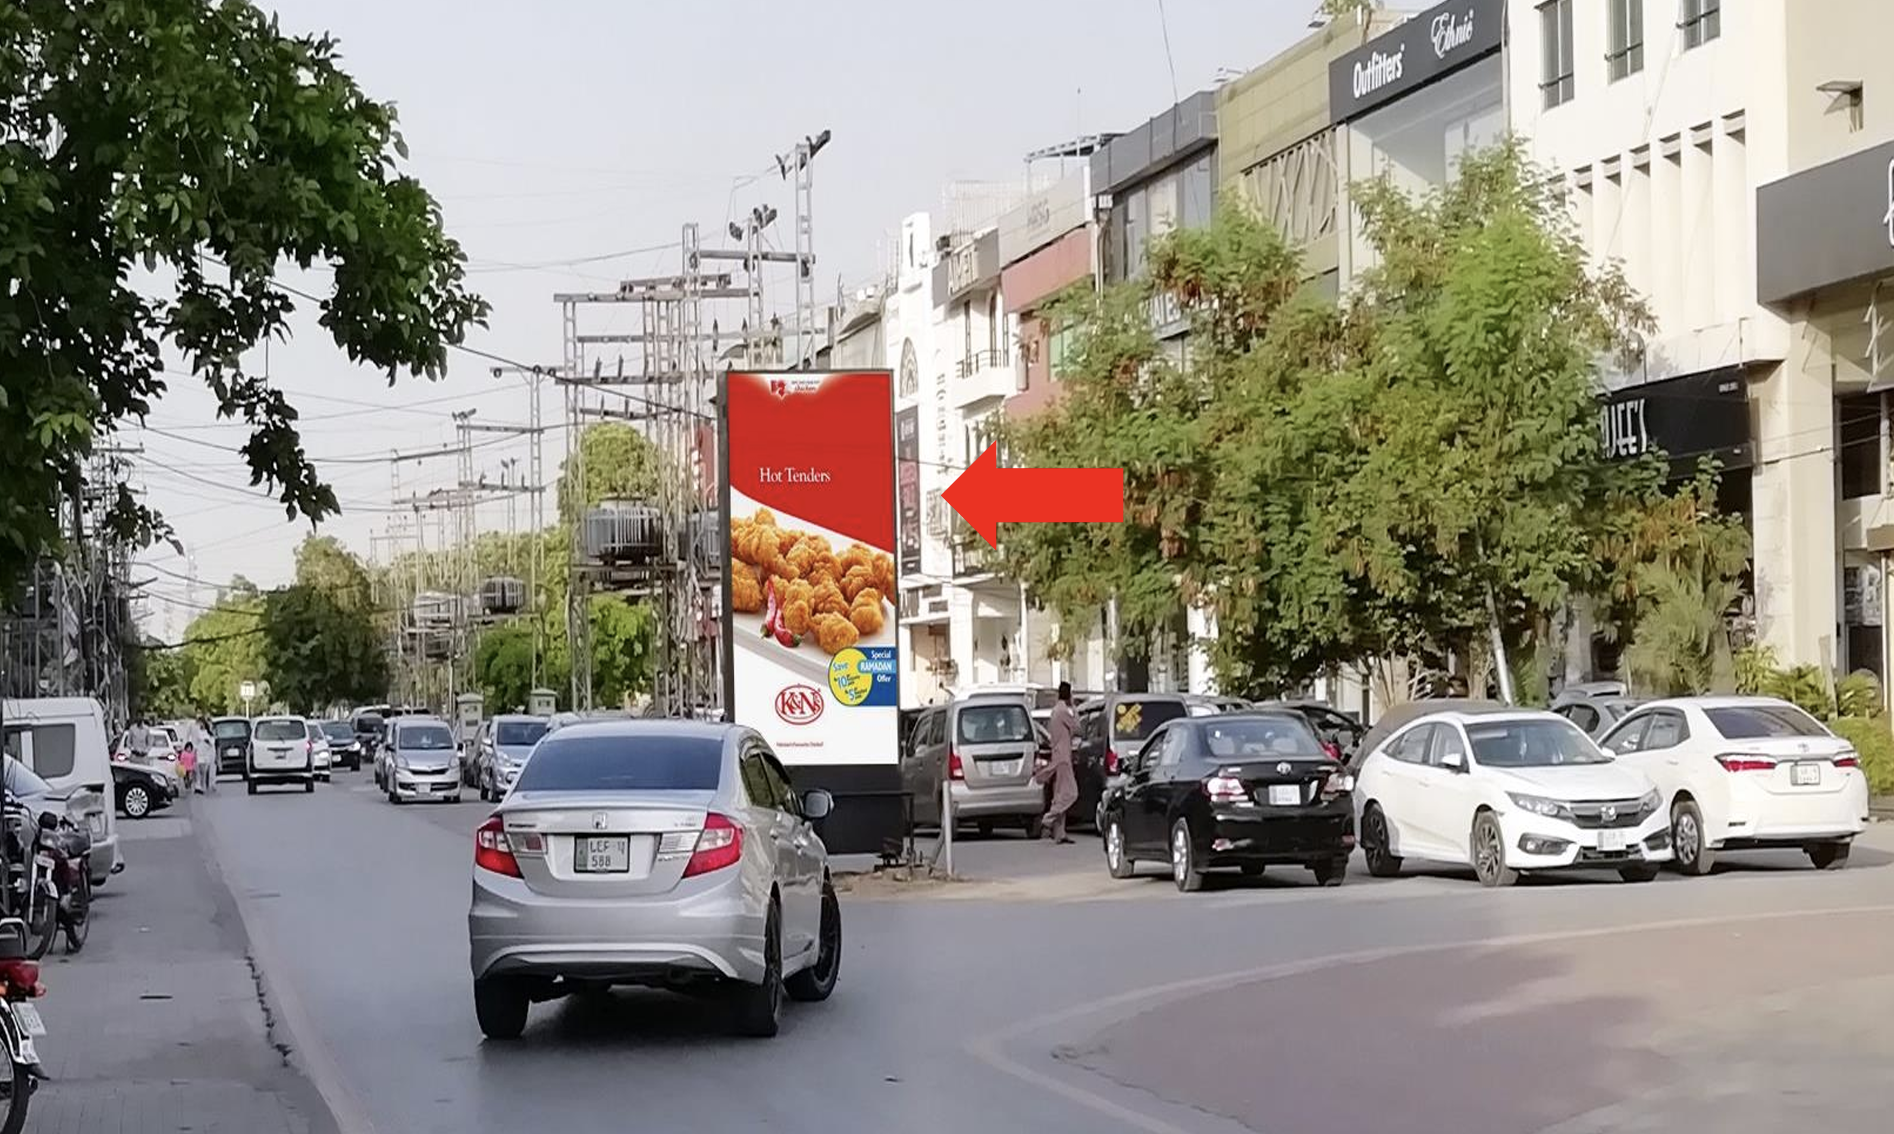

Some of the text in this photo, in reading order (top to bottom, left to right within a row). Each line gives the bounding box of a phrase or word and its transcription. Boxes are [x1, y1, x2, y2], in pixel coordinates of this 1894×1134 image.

[1431, 12, 1473, 59] Ethnic
[1353, 51, 1403, 99] Outfitters
[760, 467, 831, 483] Hot Tenders
[871, 650, 892, 659] Special
[860, 661, 892, 672] RAMADAN
[877, 674, 892, 683] Offer
